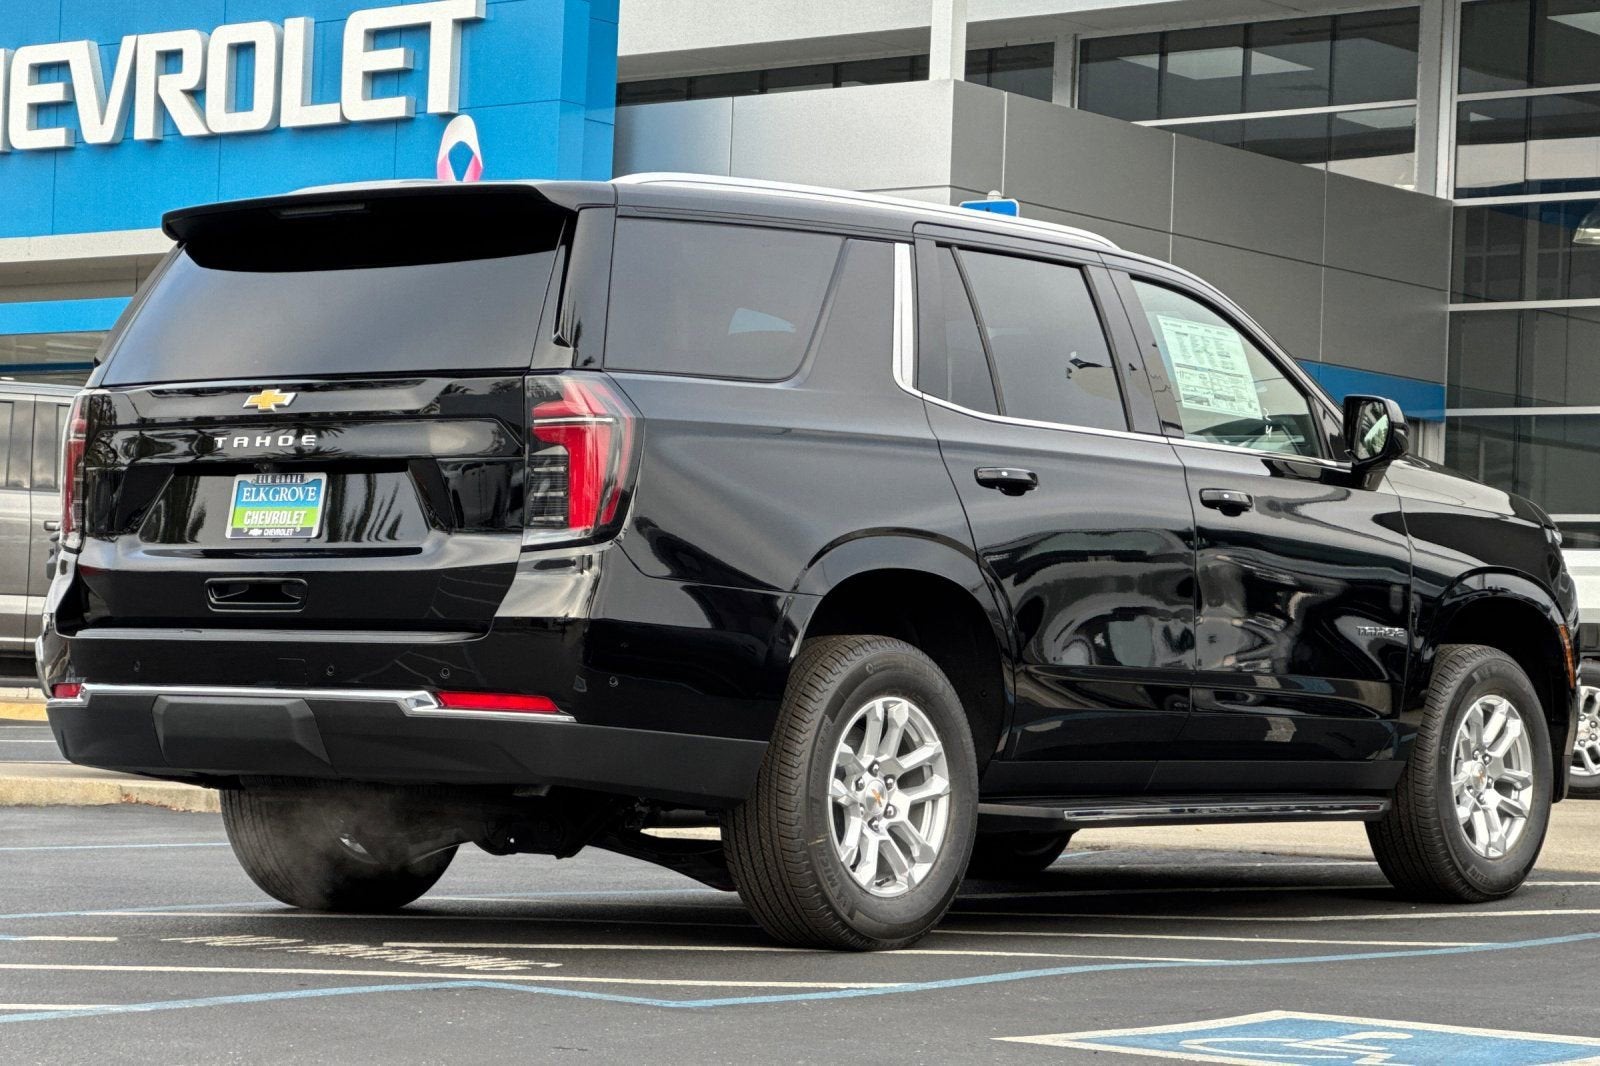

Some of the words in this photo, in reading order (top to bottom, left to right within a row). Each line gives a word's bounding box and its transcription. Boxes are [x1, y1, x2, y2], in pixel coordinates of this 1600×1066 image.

[0, 0, 486, 152] EVROLET
[214, 434, 318, 448] TAHOE
[241, 487, 269, 502] ELK
[269, 486, 317, 502] GROVE
[244, 510, 307, 526] CHEVROLET
[263, 528, 294, 536] CHEVROLET
